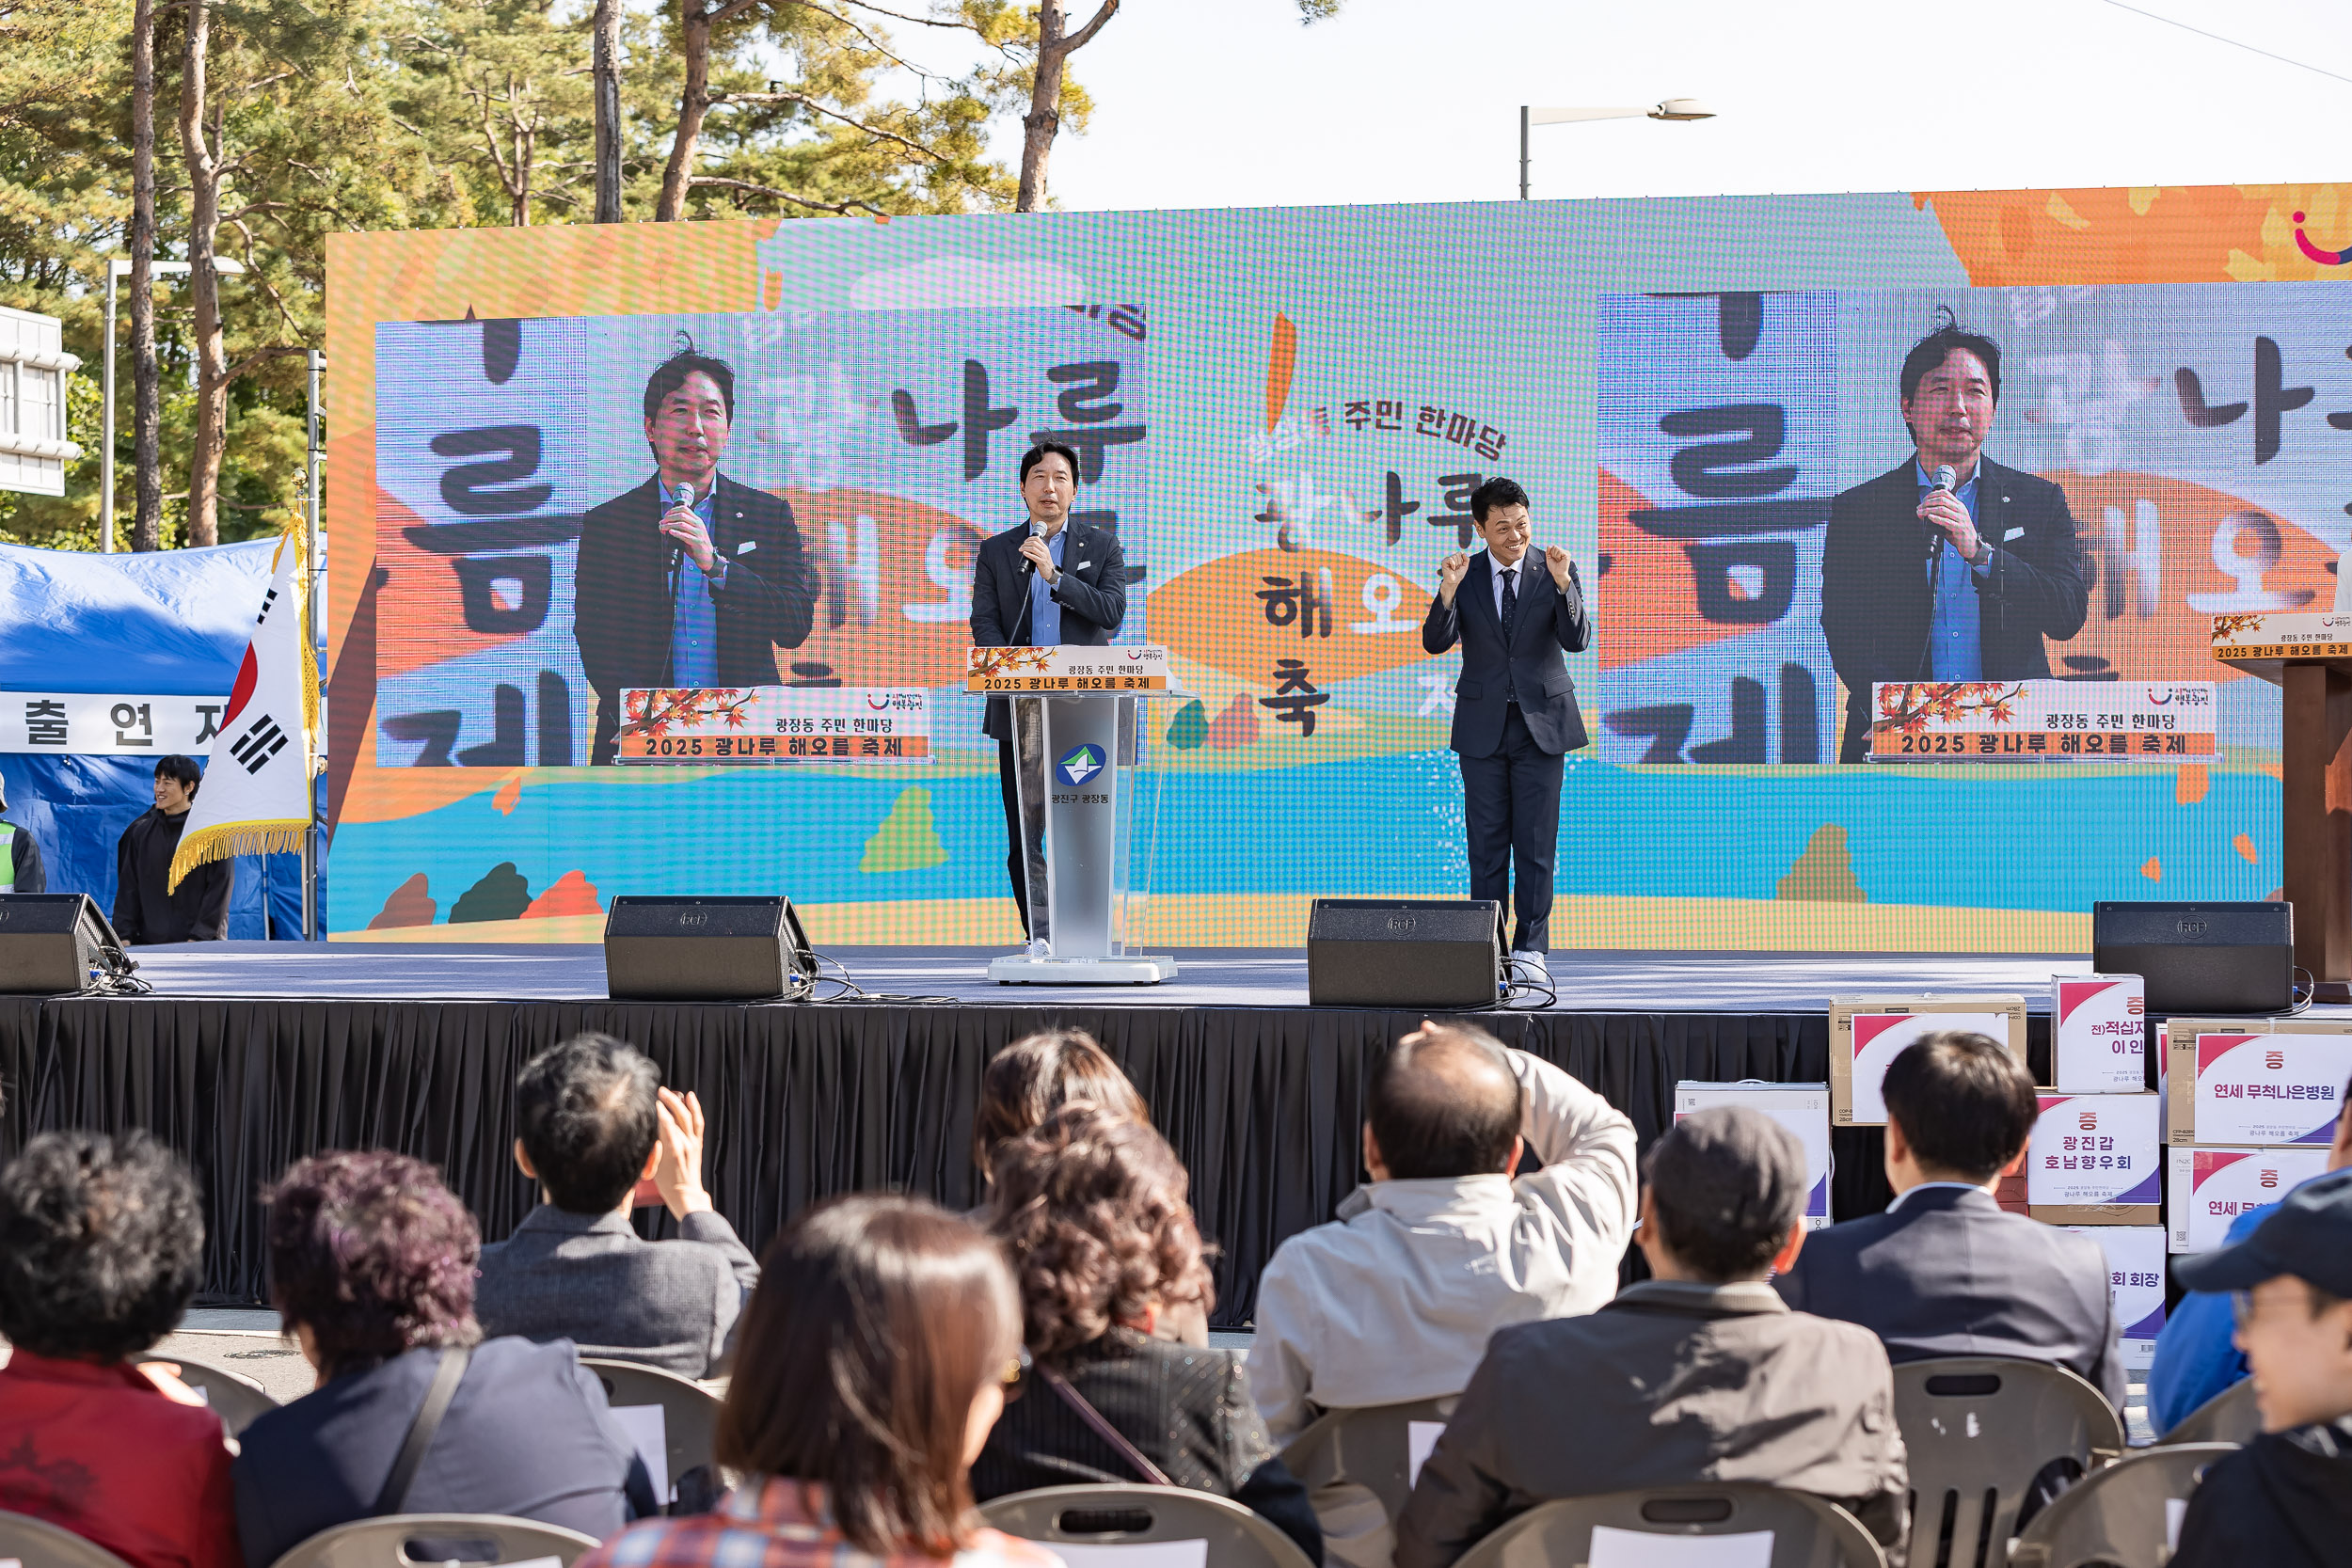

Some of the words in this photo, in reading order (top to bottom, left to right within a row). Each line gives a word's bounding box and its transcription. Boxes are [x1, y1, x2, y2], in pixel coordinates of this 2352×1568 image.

[1343, 400, 1403, 431] 주민
[1416, 405, 1507, 462] 한마당
[2217, 648, 2248, 657] 2025
[2252, 646, 2284, 657] 광나루
[2290, 645, 2321, 656] 해오름
[2328, 644, 2348, 655] 축제
[1068, 665, 1093, 675] 광장동
[1097, 665, 1114, 675] 주민
[1118, 665, 1144, 674] 한마당
[984, 678, 1022, 689] 2025
[1029, 677, 1070, 689] 광나루
[1076, 677, 1116, 689] 해오름
[1123, 677, 1150, 689] 축제
[775, 718, 813, 733] 광장동
[821, 718, 846, 733] 주민
[853, 718, 893, 733] 한마당
[2045, 714, 2089, 730] 광장동
[2096, 714, 2123, 730] 주민
[2132, 714, 2175, 730] 한마당
[645, 738, 703, 756] 2025
[715, 737, 776, 756] 광나루
[788, 737, 849, 756] 해오름
[862, 737, 902, 756] 축제
[1901, 735, 1965, 752] 2025
[1979, 734, 2046, 753] 광나루
[2060, 734, 2128, 753] 해오름
[2141, 734, 2185, 753] 축제
[1051, 794, 1078, 804] 광진구
[1082, 794, 1109, 804] 광장동
[2180, 922, 2205, 932] RCF
[2126, 996, 2144, 1015] 증
[2265, 1051, 2284, 1069] 증
[2214, 1084, 2243, 1099] 연세
[2247, 1085, 2335, 1101] 무척나은병원
[2078, 1112, 2098, 1131] 증
[2260, 1169, 2279, 1188] 증
[2208, 1200, 2237, 1216] 연세
[2130, 1273, 2159, 1288] 회장
